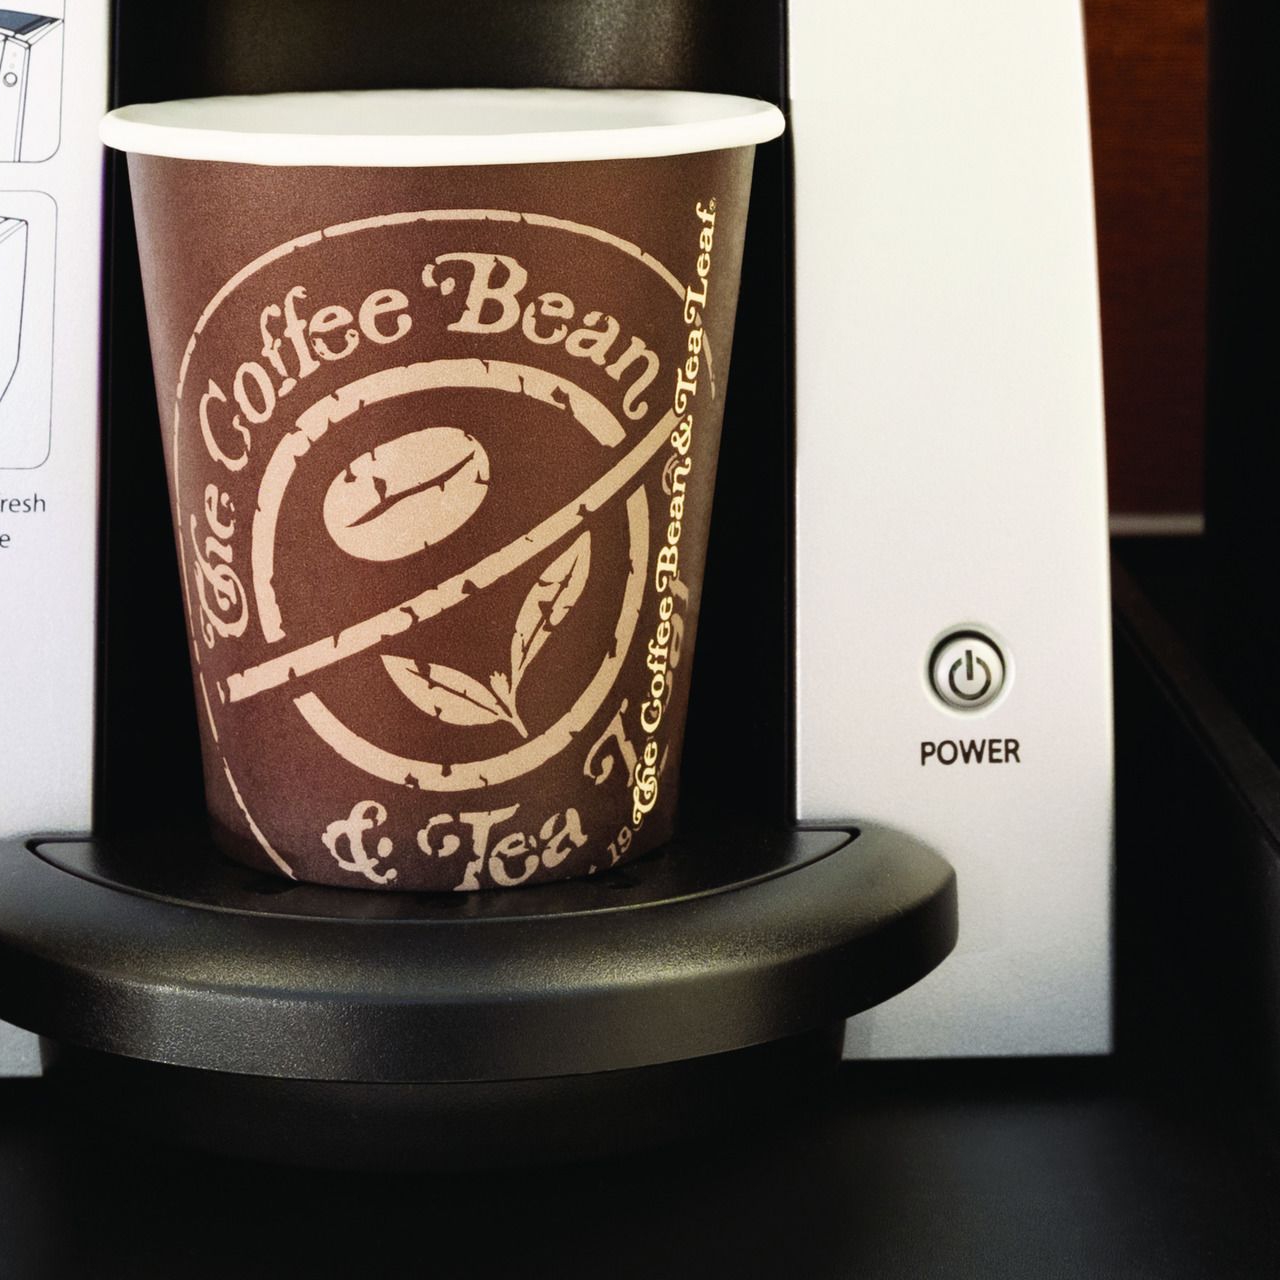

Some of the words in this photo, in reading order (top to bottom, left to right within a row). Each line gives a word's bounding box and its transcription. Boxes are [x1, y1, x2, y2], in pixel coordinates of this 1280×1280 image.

[683, 201, 717, 325] Leaf
[199, 285, 413, 472] Coffee
[422, 252, 661, 420] Bean
[674, 327, 704, 414] Tea
[671, 415, 693, 456] &
[190, 483, 250, 648] The
[655, 456, 693, 593] Bean
[640, 596, 674, 734] Coffee
[632, 741, 658, 825] The
[921, 738, 1021, 766] POWER
[321, 800, 398, 885] &
[417, 803, 589, 892] Tea
